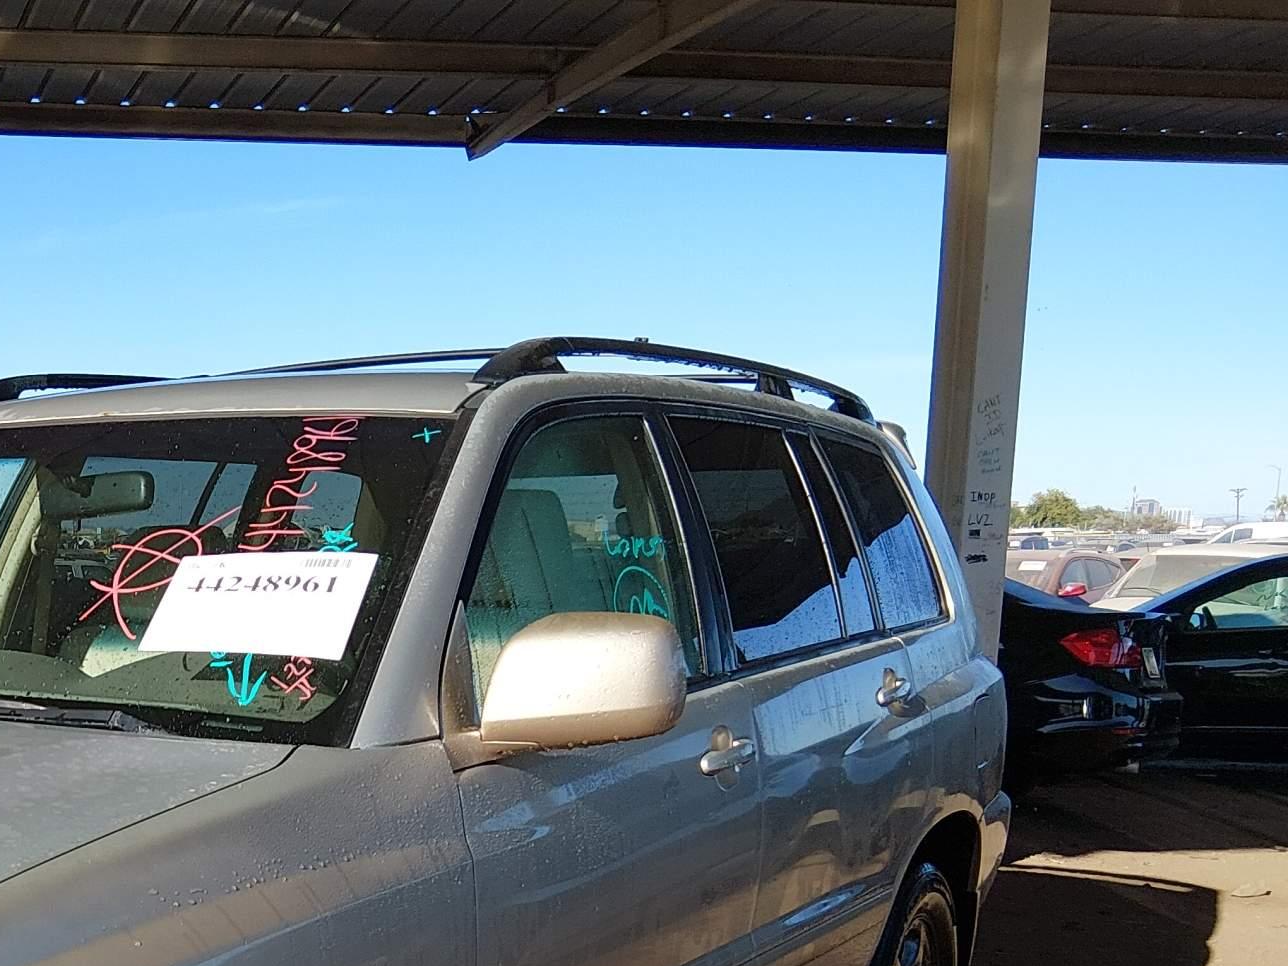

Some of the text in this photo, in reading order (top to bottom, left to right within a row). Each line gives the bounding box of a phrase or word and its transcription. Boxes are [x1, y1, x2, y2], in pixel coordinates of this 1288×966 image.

[970, 491, 996, 504] INOP
[968, 514, 993, 526] LV2
[186, 574, 338, 593] 44248961
